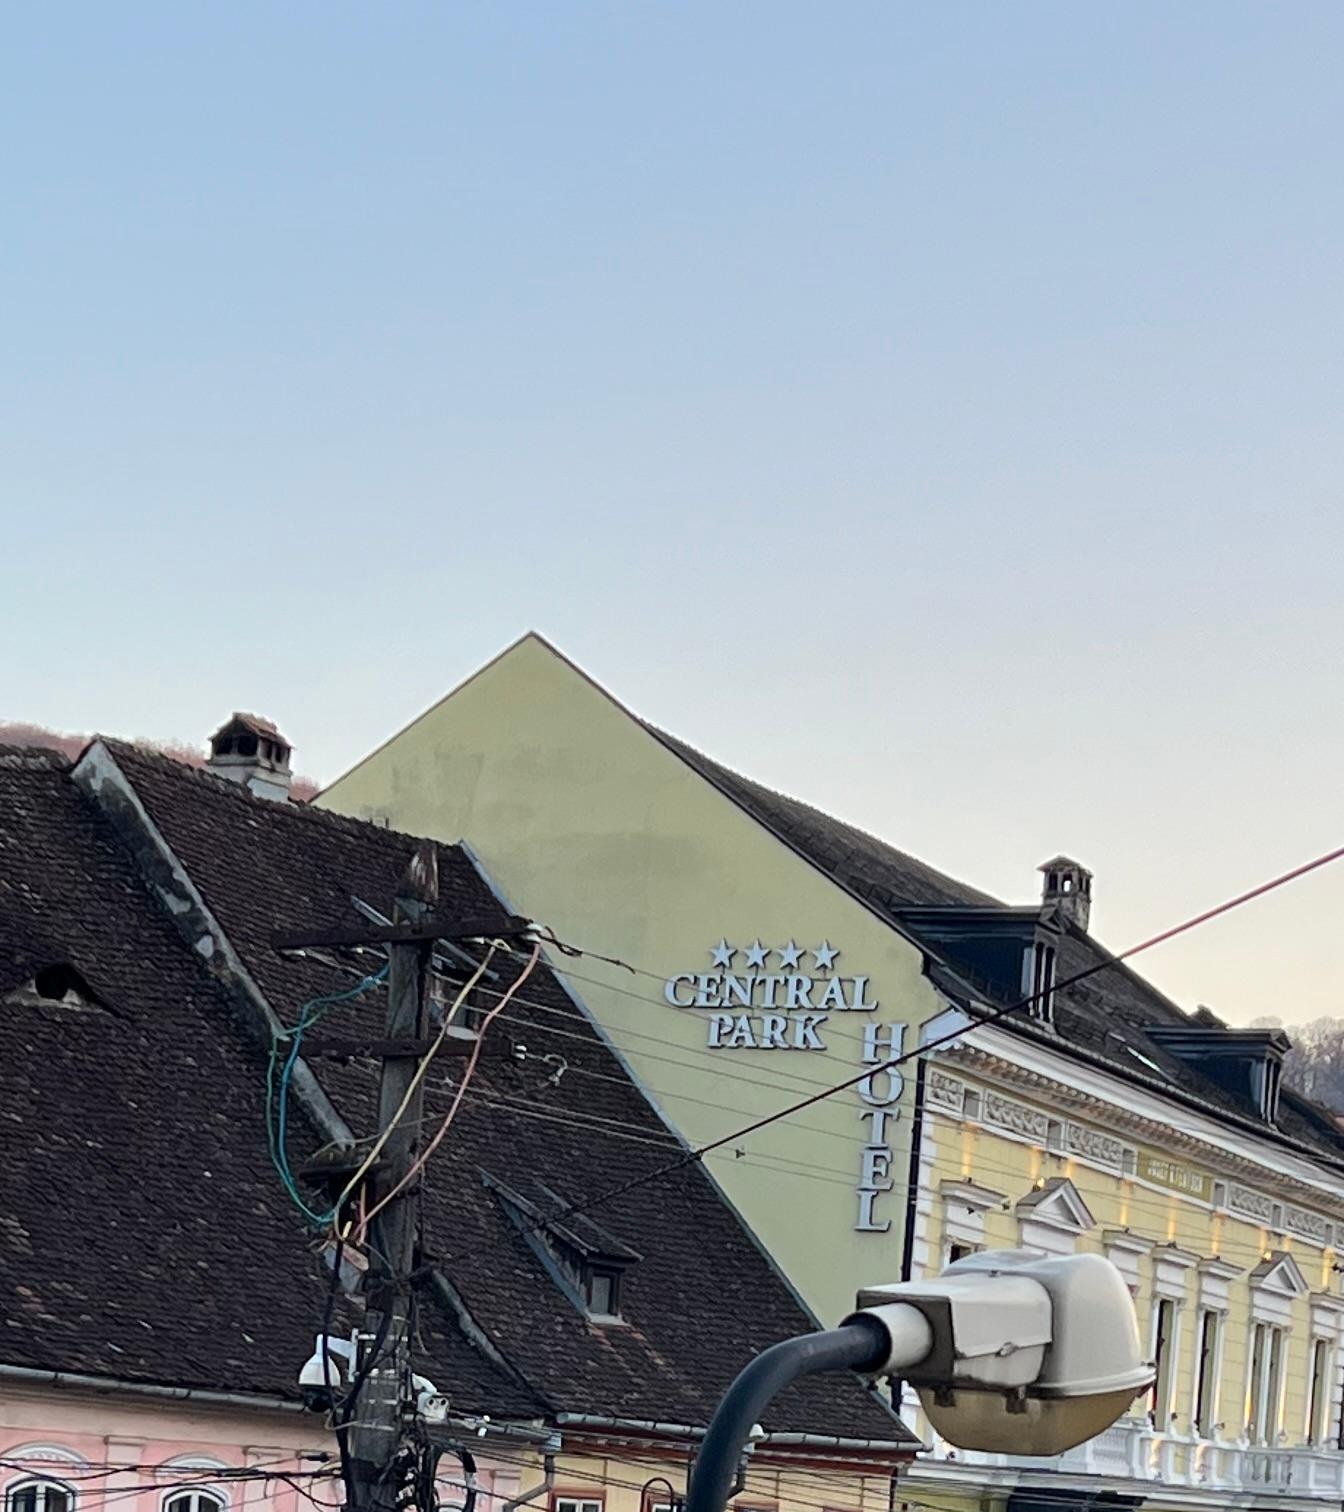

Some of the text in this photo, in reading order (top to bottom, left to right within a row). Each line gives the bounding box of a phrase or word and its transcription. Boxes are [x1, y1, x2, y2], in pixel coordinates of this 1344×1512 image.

[664, 974, 879, 1012] CENTRAL
[706, 1014, 829, 1051] PARK
[854, 1022, 908, 1232] HOTEL
